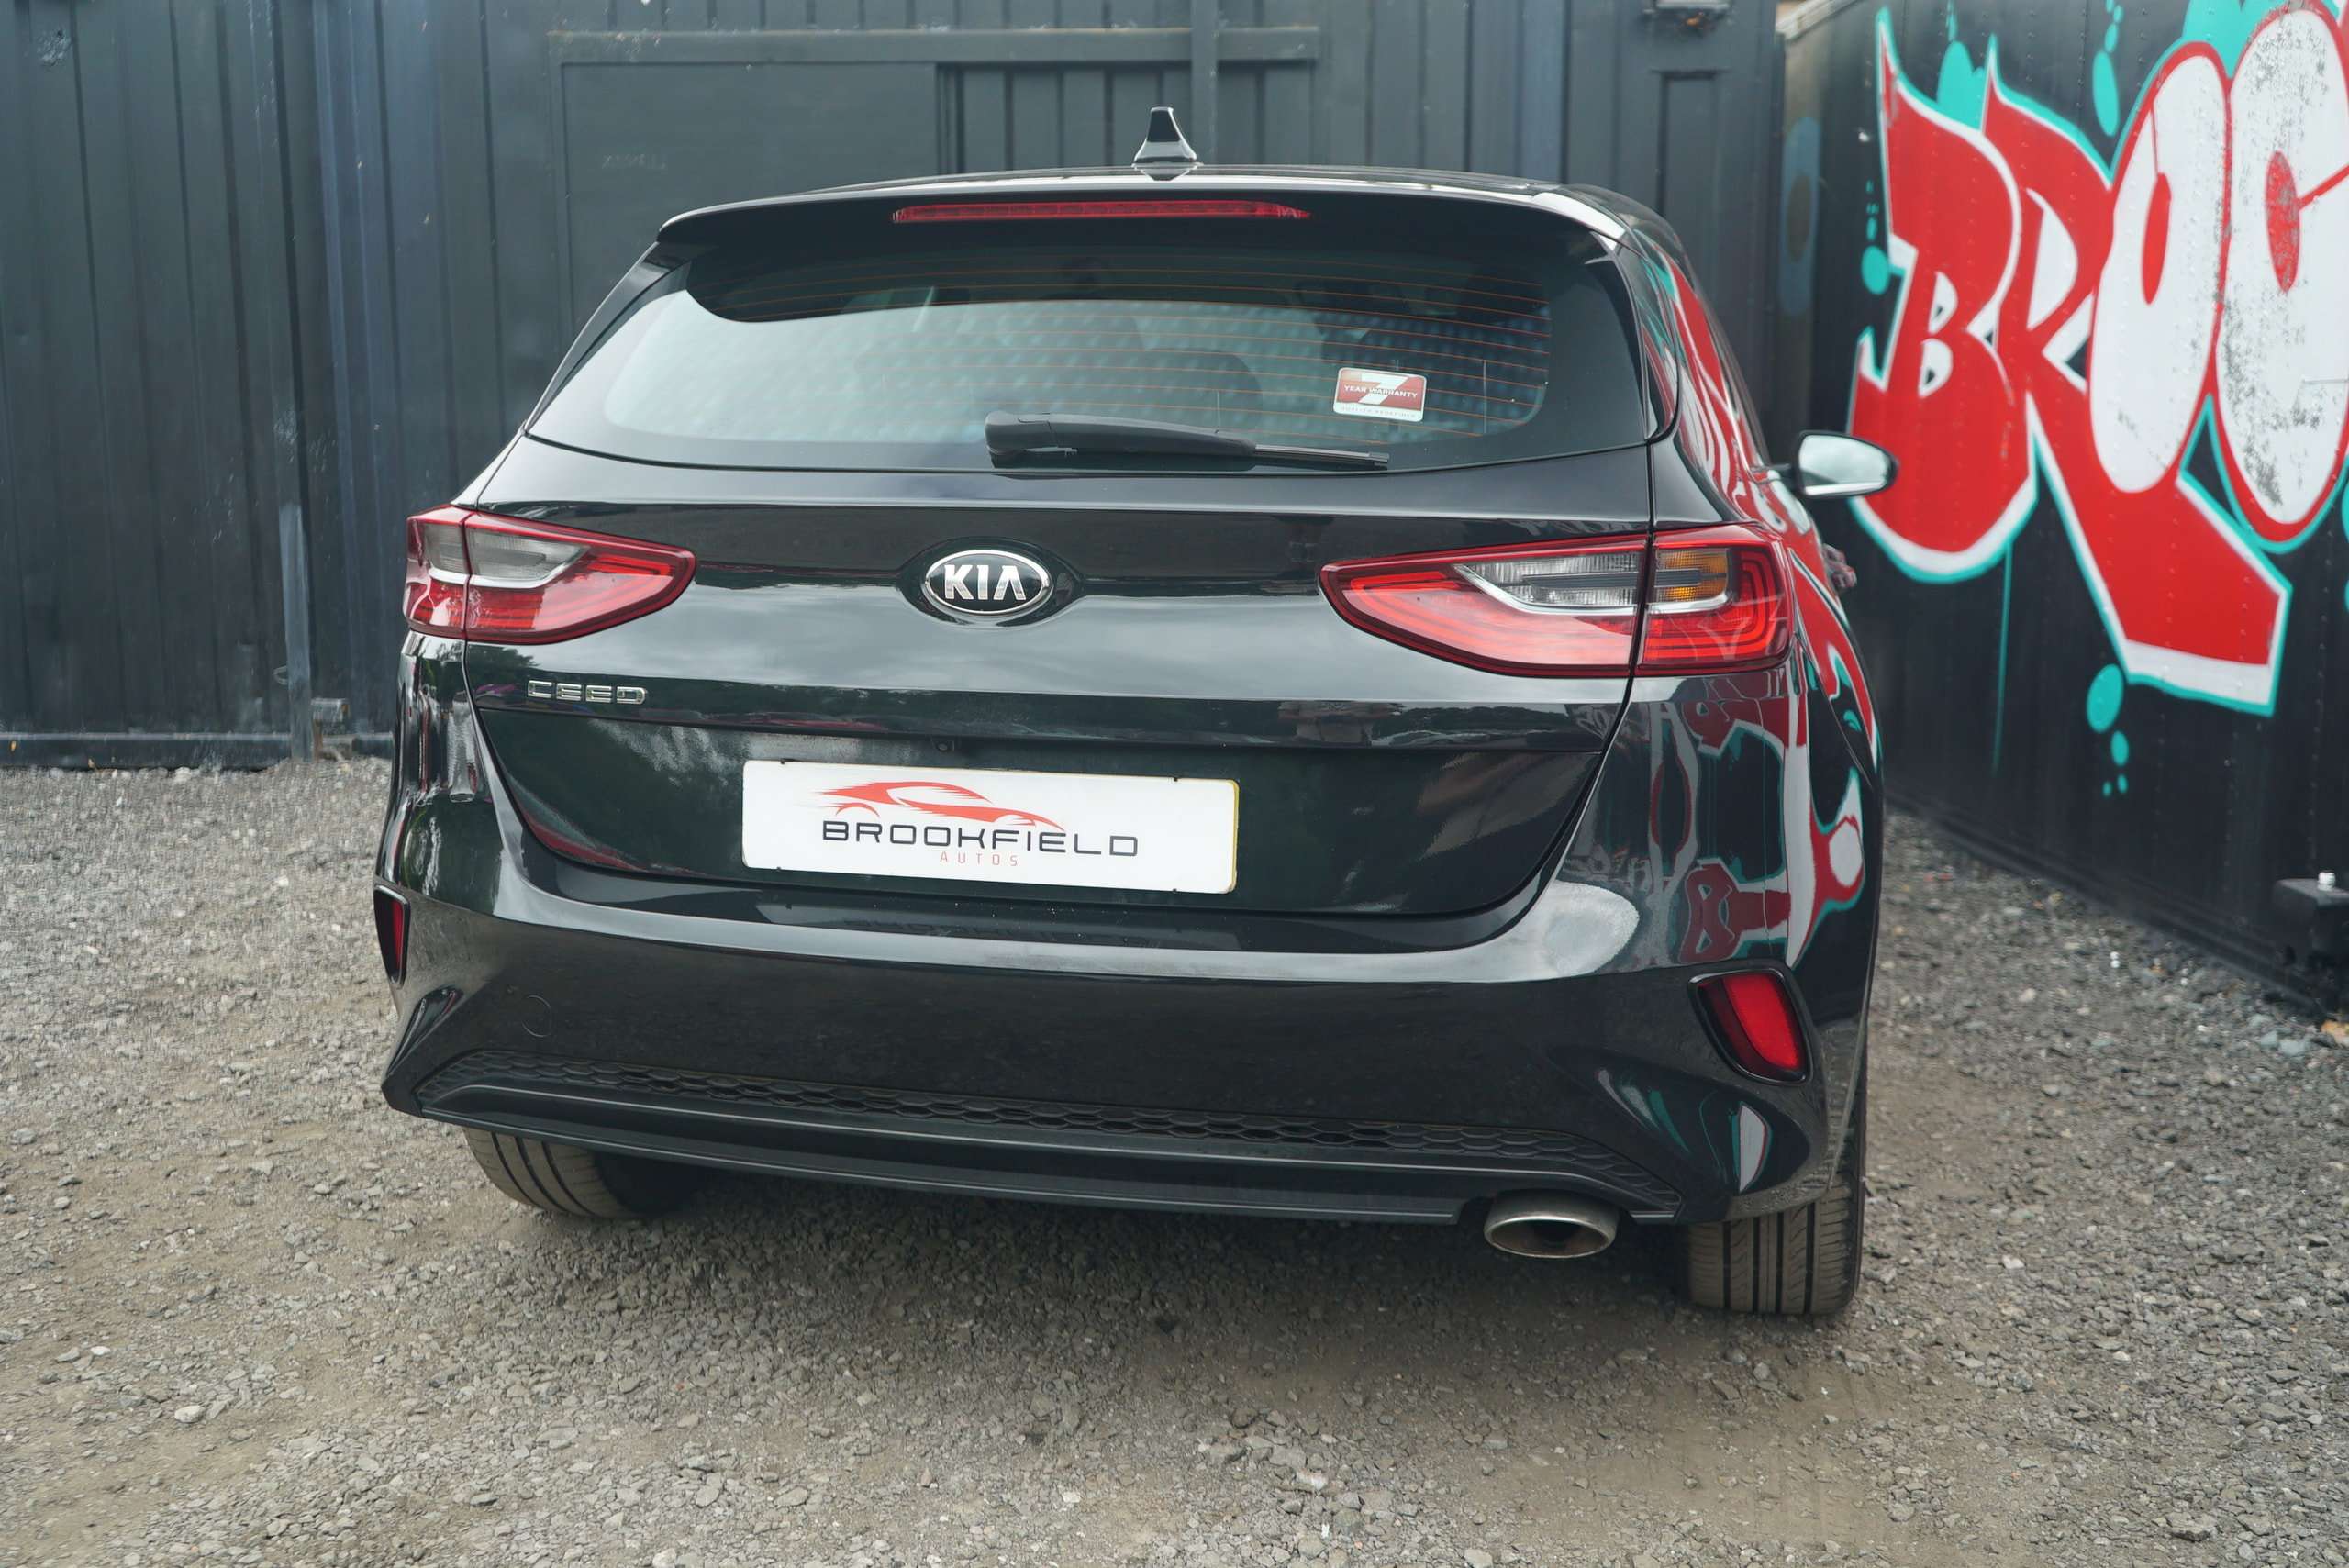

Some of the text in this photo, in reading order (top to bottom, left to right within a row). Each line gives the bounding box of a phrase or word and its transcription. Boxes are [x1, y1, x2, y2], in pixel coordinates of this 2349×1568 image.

[1343, 384, 1418, 398] YEAR WARRANTY
[944, 564, 1027, 601] KIA
[527, 679, 648, 705] CEED
[822, 820, 1139, 857] BROOKFIELD
[939, 851, 1019, 867] AUTOS
